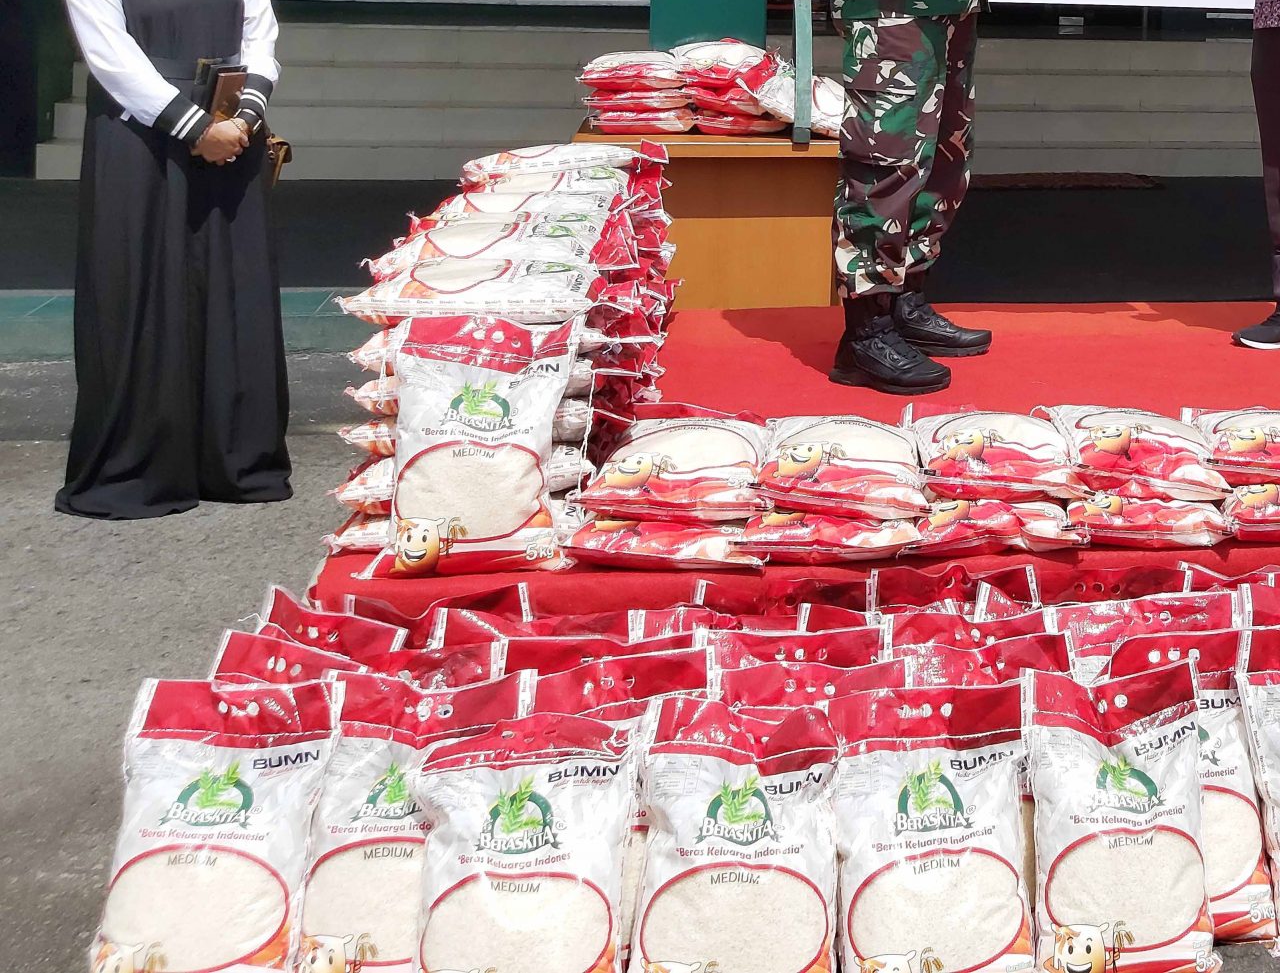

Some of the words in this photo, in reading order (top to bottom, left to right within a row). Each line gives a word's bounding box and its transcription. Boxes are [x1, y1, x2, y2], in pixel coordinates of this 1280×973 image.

[452, 447, 495, 459] MEDIUM
[1199, 696, 1242, 710] BUM
[253, 749, 320, 771] BUMN
[950, 750, 1014, 771] BUMN
[547, 764, 620, 783] BUMN
[1199, 766, 1239, 778] ndonesia"
[1101, 815, 1143, 827] Keluarga
[168, 828, 215, 841] Keluarga
[216, 828, 270, 842] Indonesia"
[360, 823, 406, 835] Keluarga
[905, 835, 949, 849] Keluarga
[1108, 834, 1154, 850] MEDIUM
[363, 846, 415, 861] MEDIUM
[706, 846, 752, 860] Keluarga
[486, 856, 533, 871] Keluarga
[534, 852, 572, 867] Indones
[710, 872, 760, 885] MEDIUM
[490, 881, 541, 894] MEDIUM
